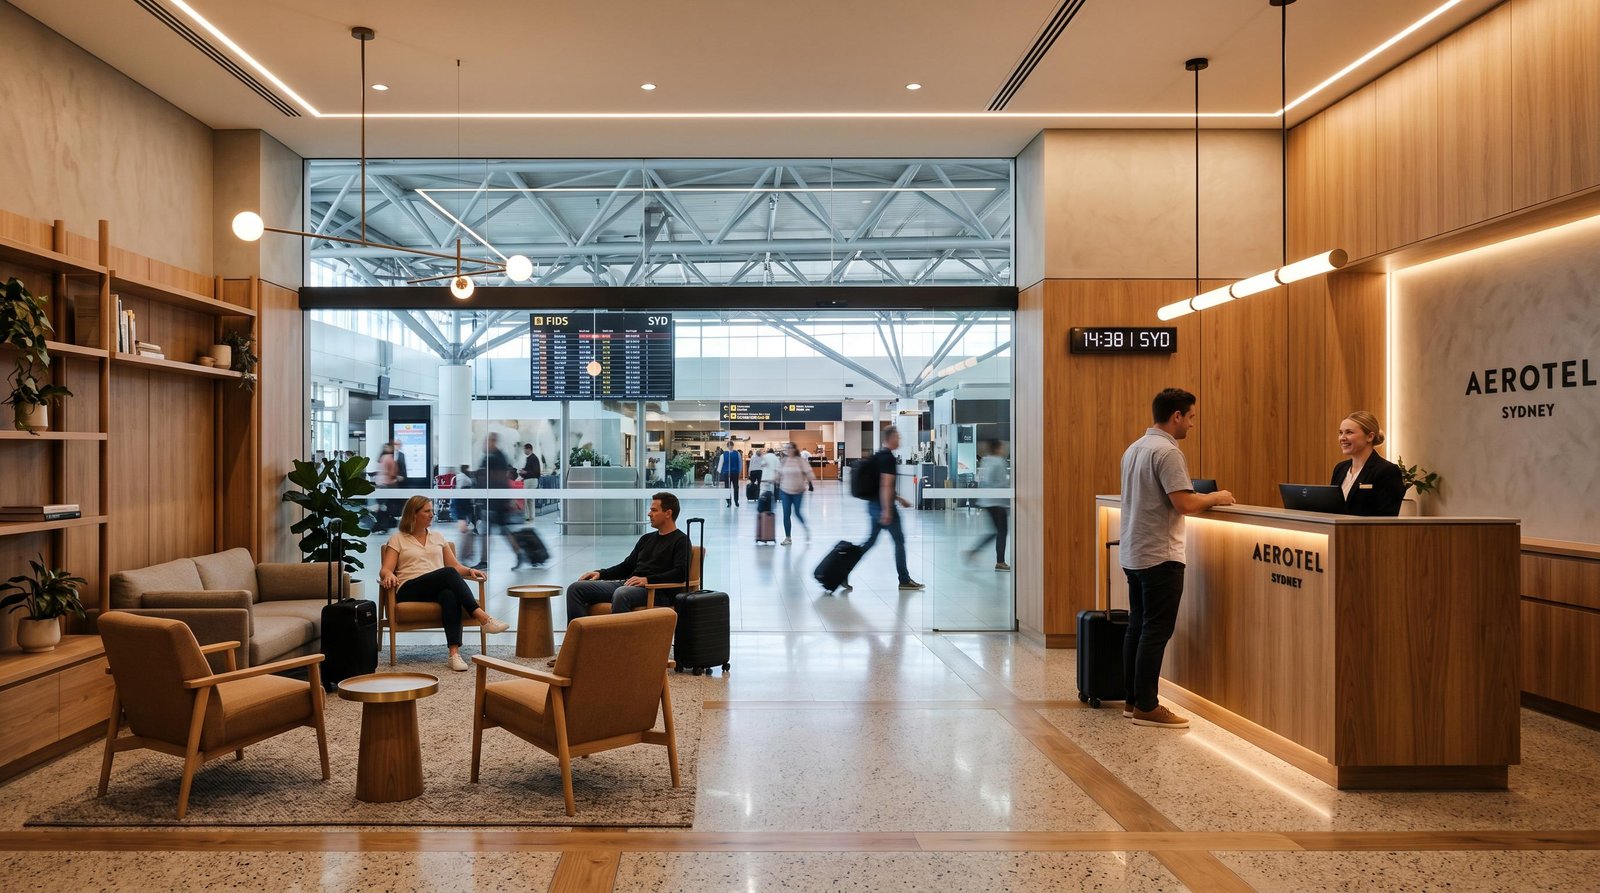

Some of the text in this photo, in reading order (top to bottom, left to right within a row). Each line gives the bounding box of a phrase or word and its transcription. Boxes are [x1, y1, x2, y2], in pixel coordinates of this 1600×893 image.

[546, 316, 569, 326] FIDS
[648, 316, 668, 326] SYD
[1083, 332, 1124, 347] 14:38
[1139, 332, 1170, 347] SYD
[1465, 359, 1597, 395] AEROTEL
[1501, 403, 1555, 419] SYDNEY
[1252, 542, 1324, 573] AEROTEL
[1271, 572, 1303, 589] SYDNEY
